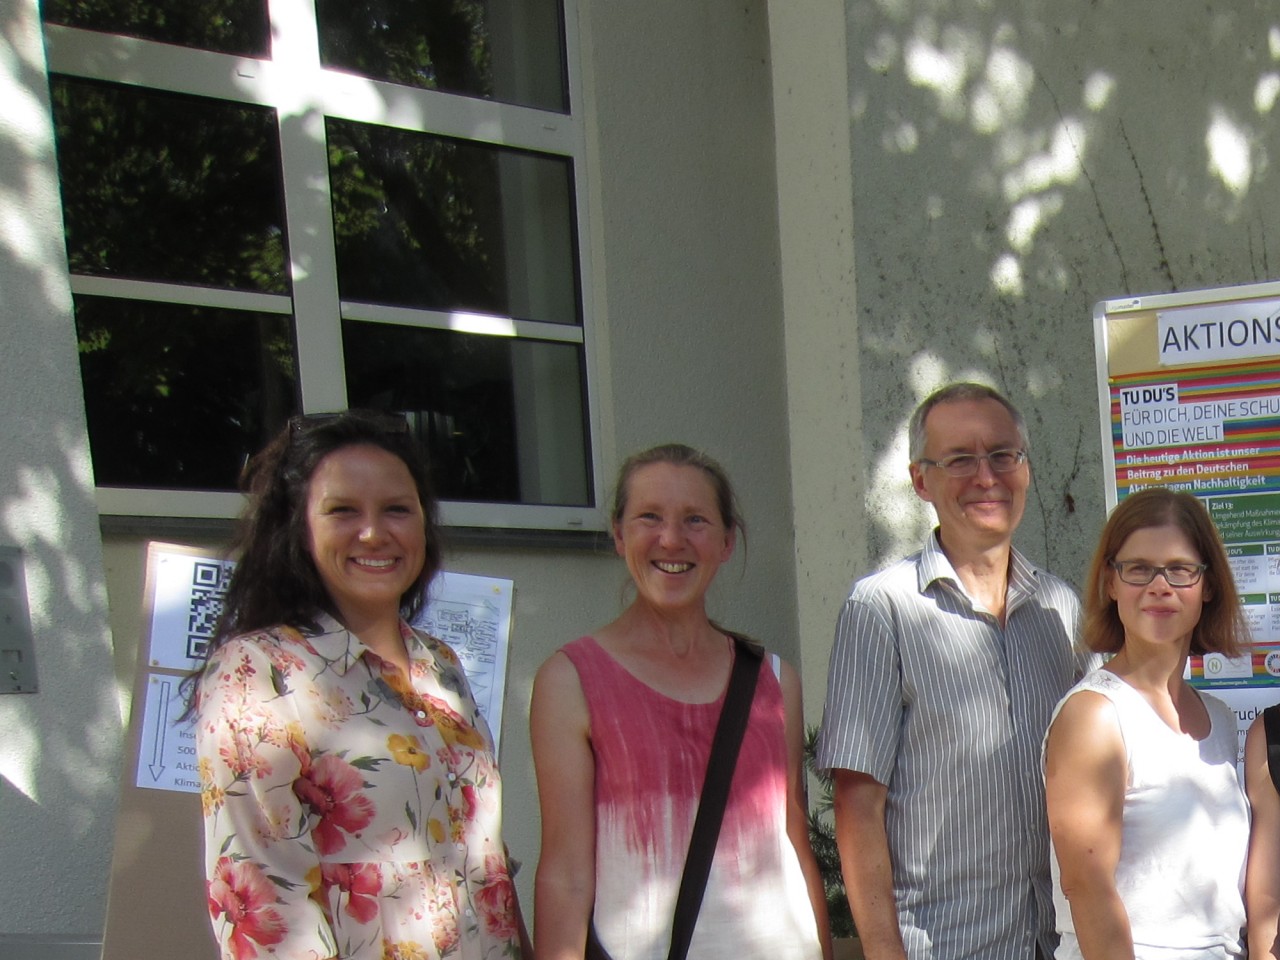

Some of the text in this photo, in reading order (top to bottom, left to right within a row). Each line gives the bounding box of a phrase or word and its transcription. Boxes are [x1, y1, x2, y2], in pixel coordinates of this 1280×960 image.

[1122, 387, 1175, 406] TU DU'S
[1124, 408, 1151, 426] FÜR
[1154, 406, 1191, 424] DICH,
[1193, 403, 1236, 420] DEINE
[1125, 425, 1220, 448] UND DIE WELT
[1126, 447, 1260, 465] Die heutige Aktion ist unser
[1127, 461, 1249, 481] Beitrag zu den Deutschen
[1193, 475, 1266, 490] Nachhaltigkeit
[1212, 502, 1224, 510] Ziel
[177, 746, 196, 756] 500
[174, 778, 201, 788] Klima
